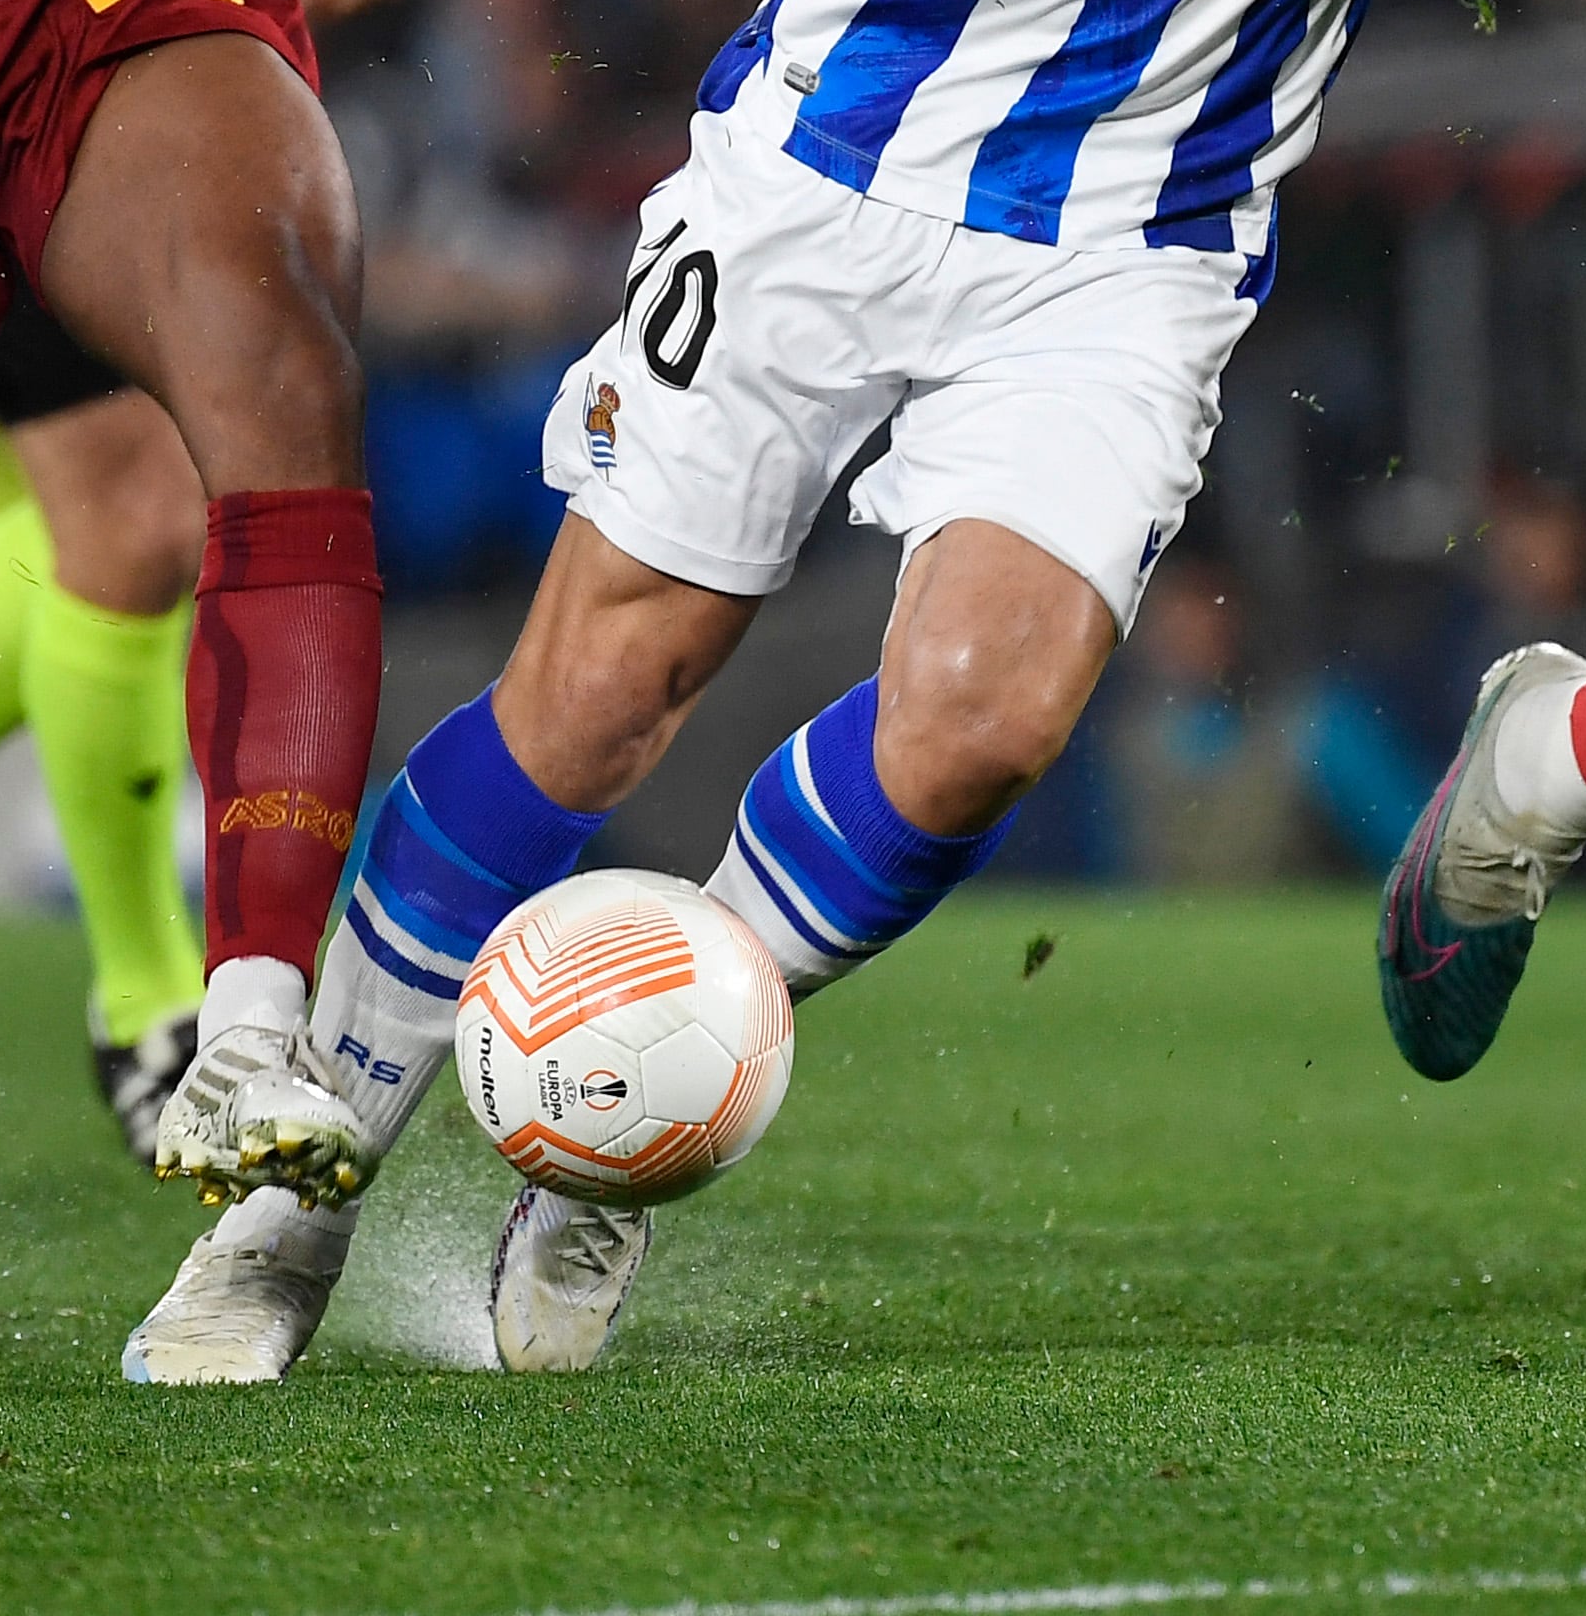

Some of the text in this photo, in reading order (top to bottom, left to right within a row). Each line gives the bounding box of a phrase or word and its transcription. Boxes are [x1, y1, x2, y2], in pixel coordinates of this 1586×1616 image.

[620, 217, 719, 391] 10
[337, 1033, 406, 1084] RS
[480, 1026, 501, 1127] molten
[538, 1072, 549, 1109] LEAGUE
[546, 1060, 564, 1121] EUROPA
